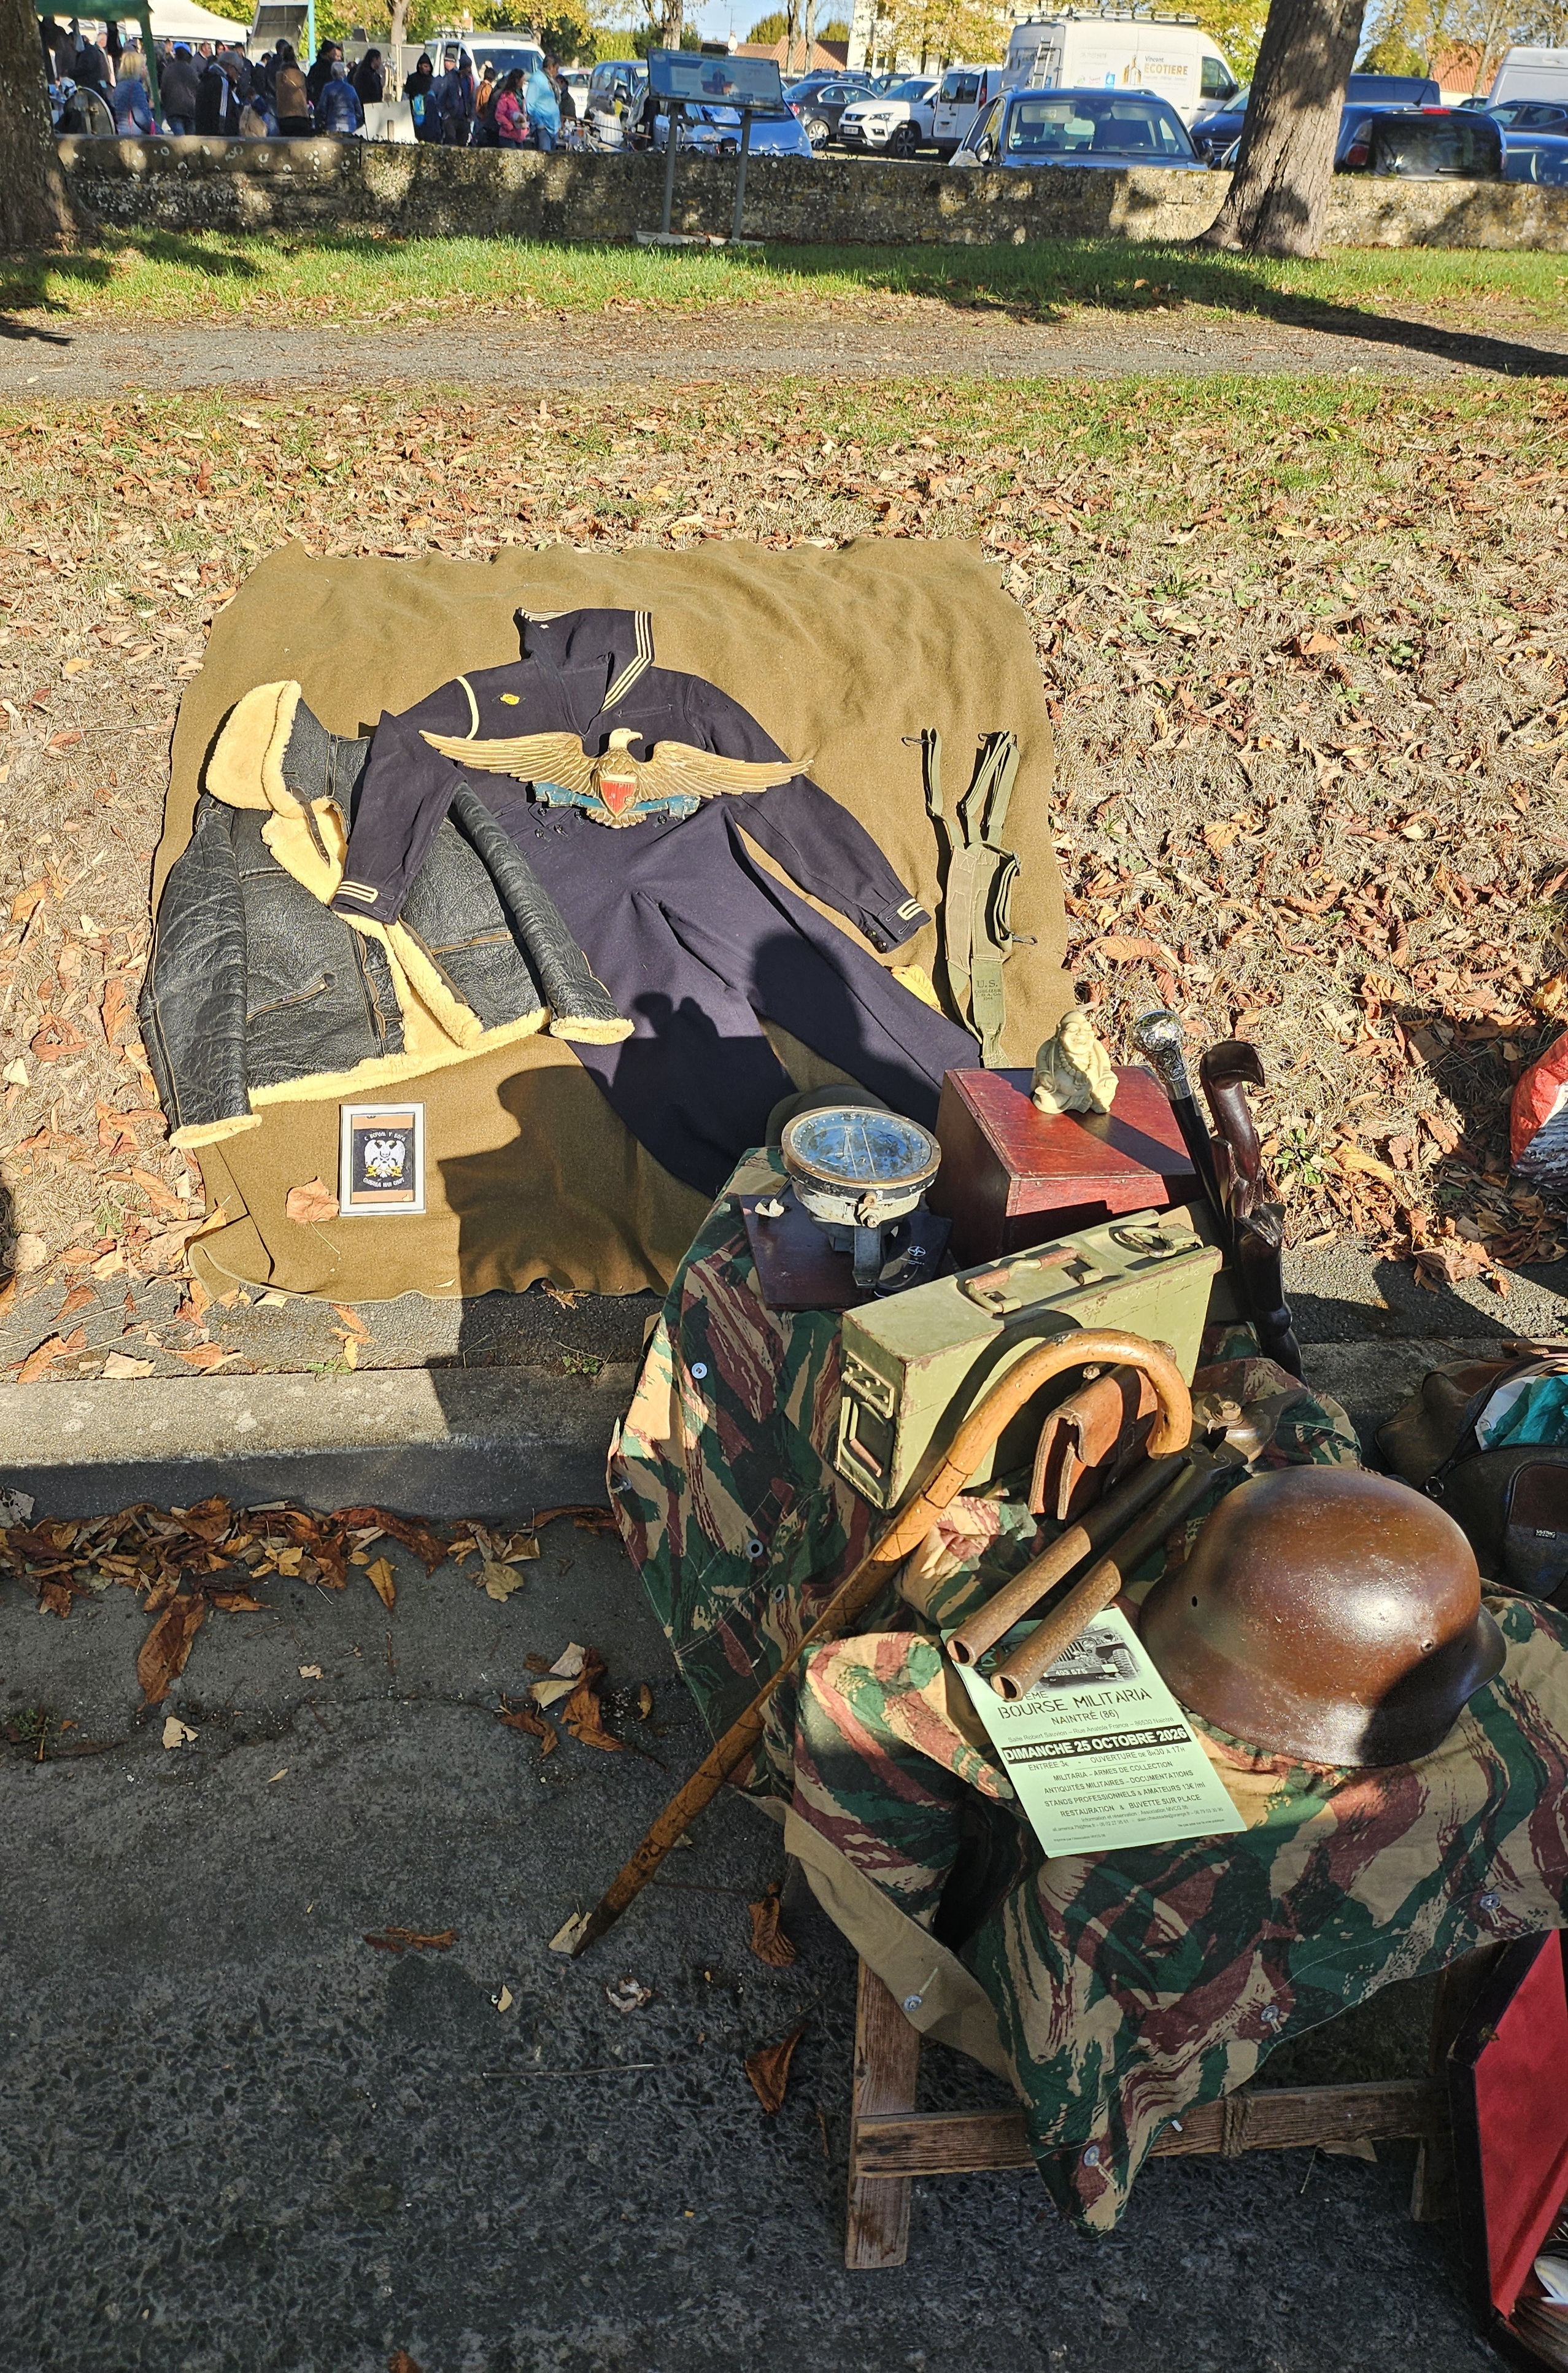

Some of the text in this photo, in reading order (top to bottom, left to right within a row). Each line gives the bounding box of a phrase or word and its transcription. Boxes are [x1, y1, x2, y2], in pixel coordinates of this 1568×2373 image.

[1144, 63, 1188, 75] ECOTIERE
[998, 1688, 1152, 1719] BOURSE MILITARIA
[1051, 1709, 1119, 1725] NAINTRÉ (86)
[1003, 1728, 1188, 1761] DIMANCHE 25 OCTOBRE 2026
[1028, 1761, 1059, 1771] ENTRÉE
[1091, 1752, 1137, 1763] OUVERTURE
[1053, 1772, 1087, 1781] MILITARIA
[1130, 1762, 1173, 1771] COLLECTION
[1045, 1783, 1084, 1794] ANTIQUITÉS
[1086, 1779, 1124, 1788] MILITAIRES
[1130, 1770, 1193, 1783] DOCUMENTATIONS
[1073, 1790, 1136, 1803] PROFESSIONNELS
[1143, 1785, 1181, 1795] AMATEURS
[1060, 1805, 1114, 1816] RESTAURATION
[1129, 1800, 1161, 1808] BUVETTE
